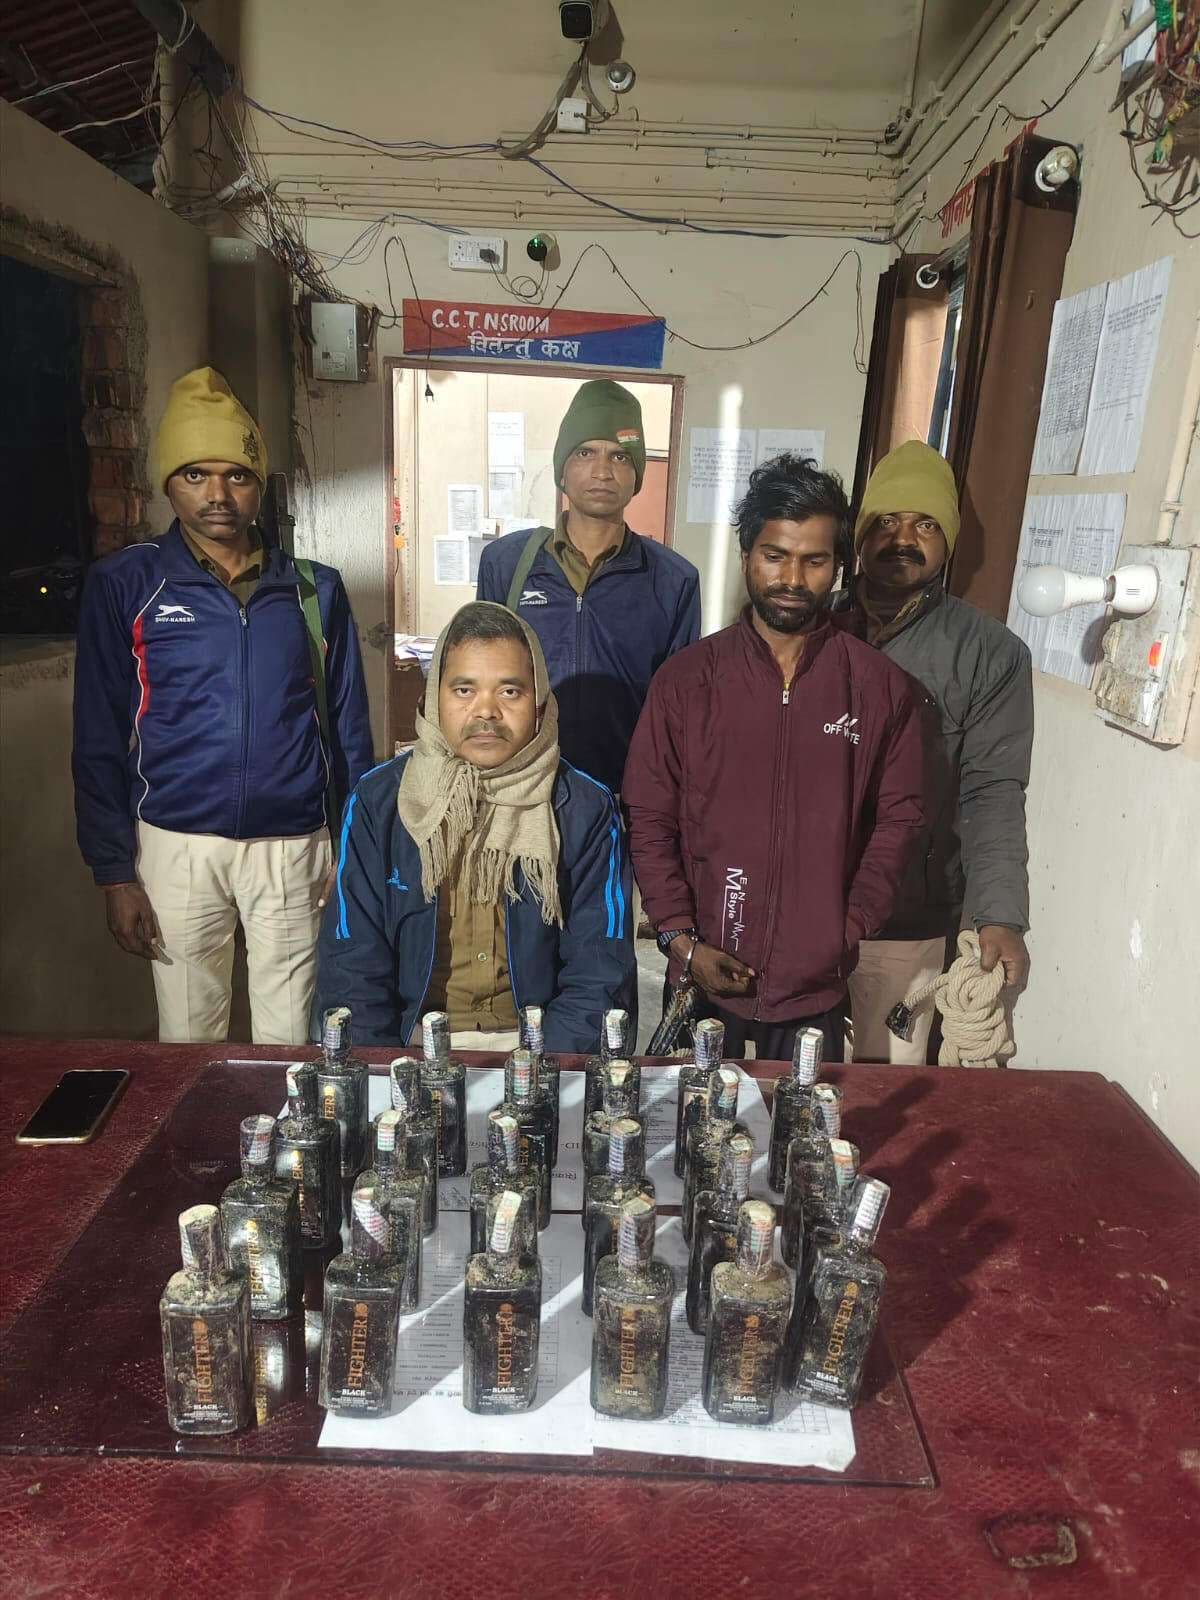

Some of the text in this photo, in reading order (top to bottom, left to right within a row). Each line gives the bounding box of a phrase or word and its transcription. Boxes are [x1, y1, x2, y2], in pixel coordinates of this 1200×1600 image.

[823, 723, 843, 735] OFF
[727, 892, 738, 919] Style
[822, 1300, 856, 1374] FIGHTER
[347, 1319, 368, 1388] FIGHTER
[497, 1312, 514, 1388] FIGHTER
[816, 1371, 840, 1384] BLACK
[341, 1388, 366, 1396] BLACK
[491, 1386, 516, 1394] BLACK
[193, 1404, 218, 1412] BLACK
